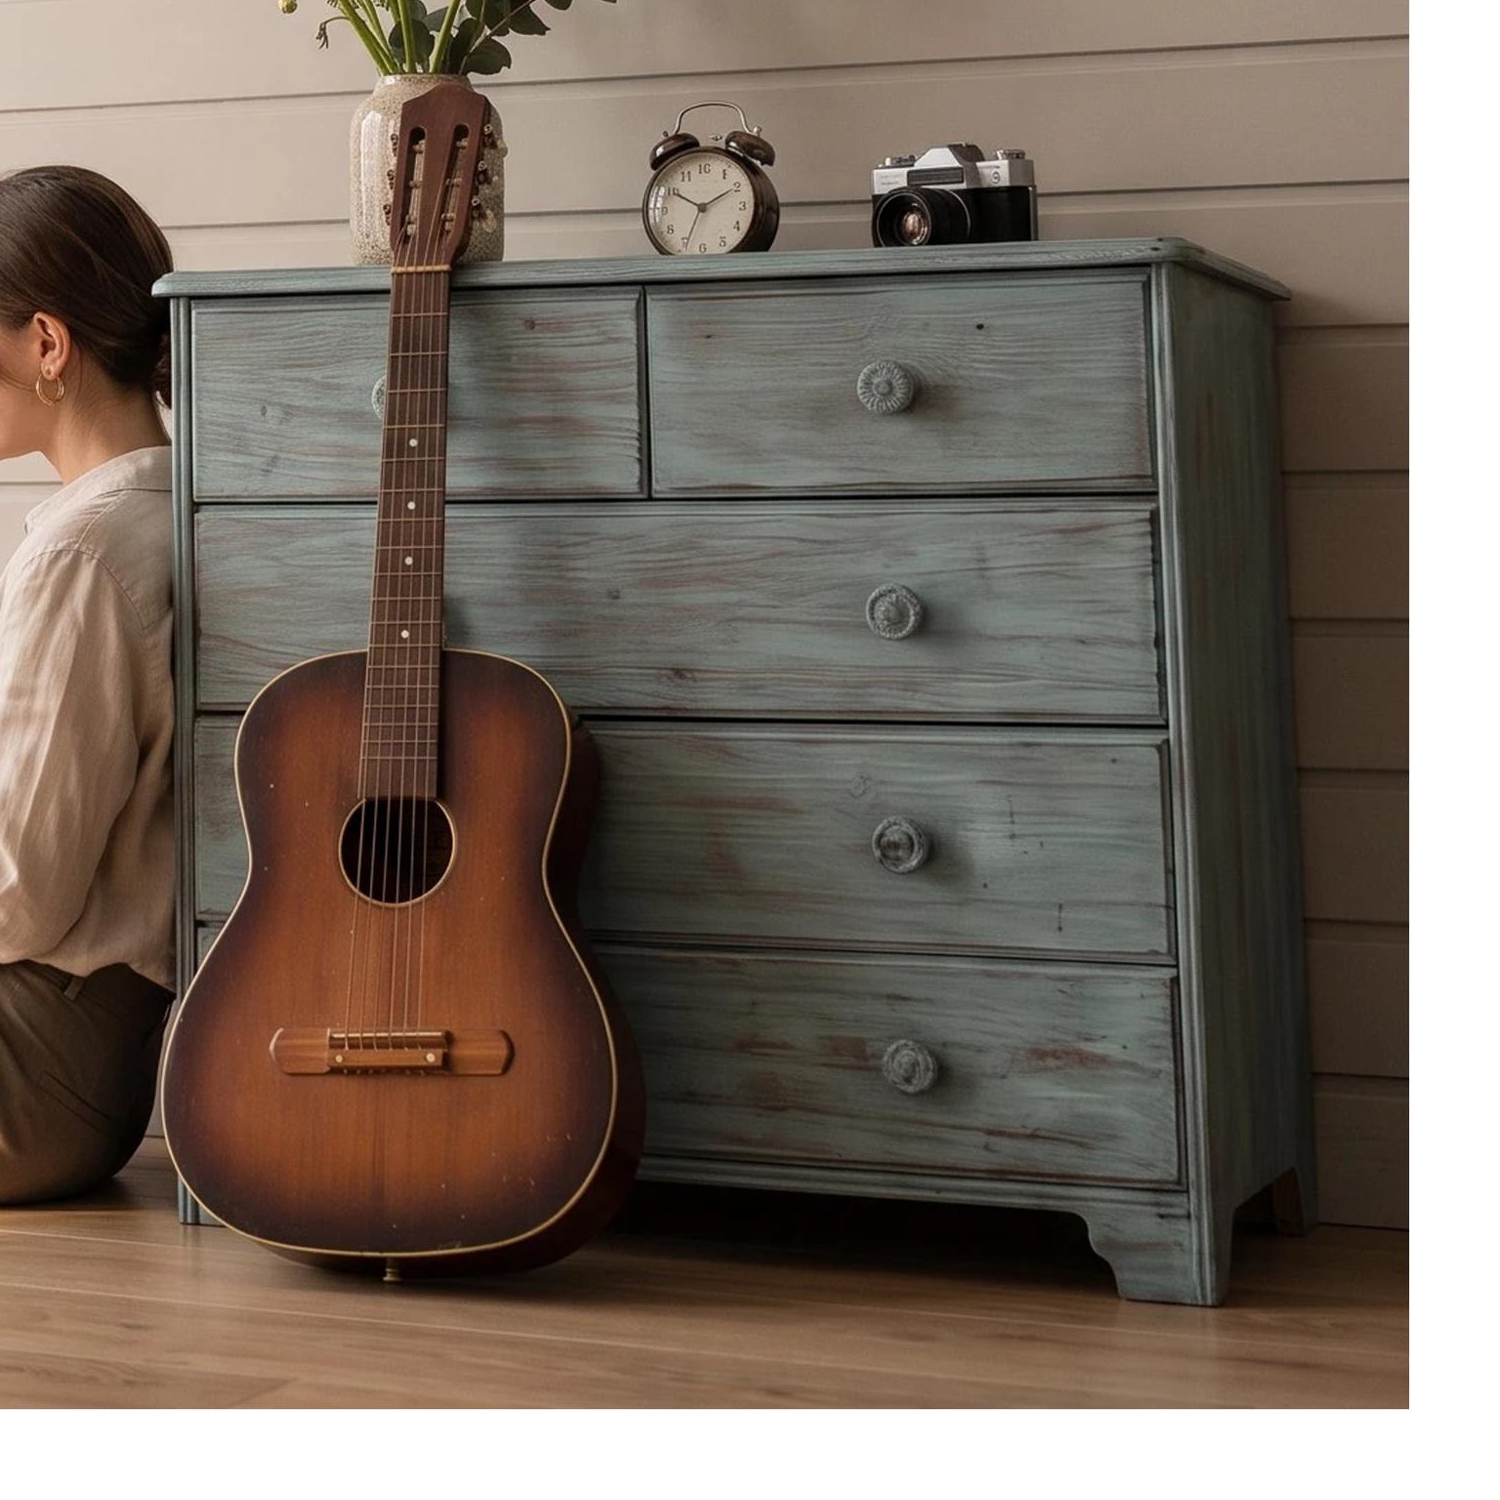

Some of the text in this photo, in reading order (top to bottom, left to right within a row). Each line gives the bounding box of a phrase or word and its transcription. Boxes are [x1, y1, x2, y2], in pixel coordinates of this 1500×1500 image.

[680, 171, 691, 182] 11
[733, 181, 741, 193] 2
[739, 201, 747, 211] 3
[733, 220, 740, 232] 4
[698, 243, 707, 254] 6
